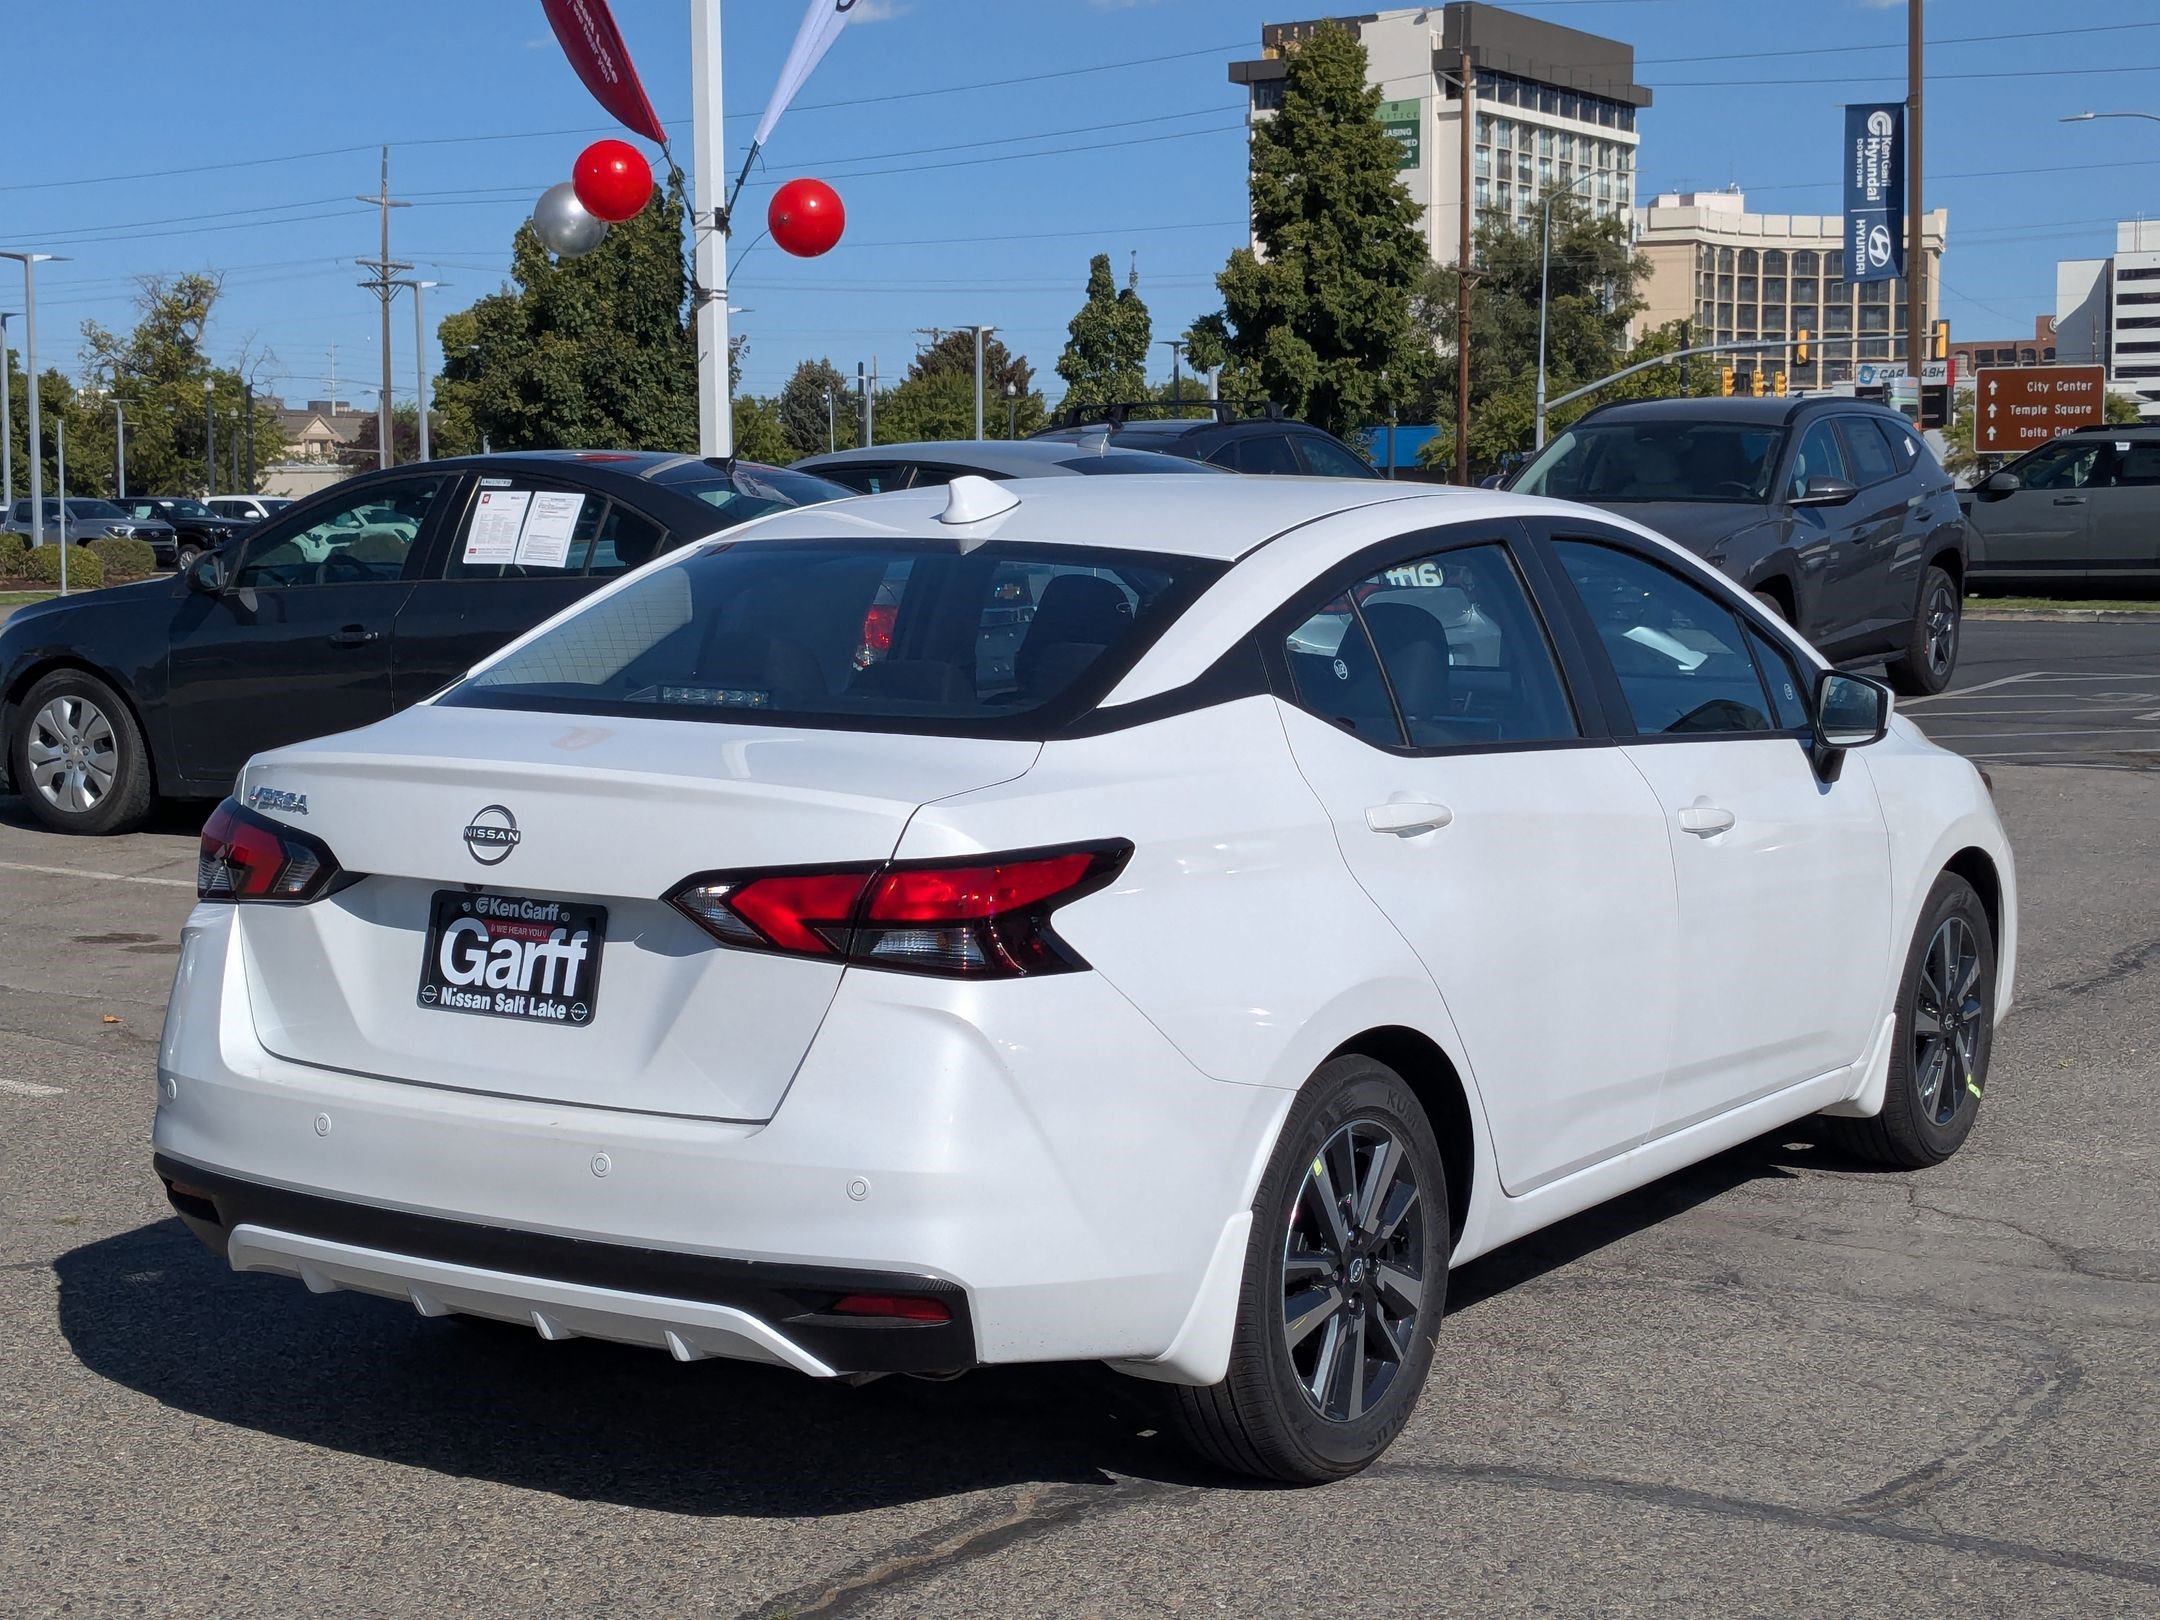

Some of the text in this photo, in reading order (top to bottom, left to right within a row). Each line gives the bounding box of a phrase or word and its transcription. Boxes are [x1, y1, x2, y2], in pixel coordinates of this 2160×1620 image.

[1382, 127, 1412, 137] EASING
[1865, 138, 1880, 201] Hyundai
[1856, 219, 1866, 275] HYUNDAI
[1880, 367, 1945, 378] CAR ASH
[2027, 380, 2093, 393] City Center
[2010, 403, 2092, 416] Temple Square
[2020, 426, 2048, 438] Delta
[464, 828, 519, 842] NISSAN
[489, 898, 519, 917] Ken
[520, 901, 560, 921] Garff
[496, 925, 544, 937] WE HEAR YOU
[440, 917, 588, 997] Garff
[441, 987, 566, 1020] Nissan Salt Lake
